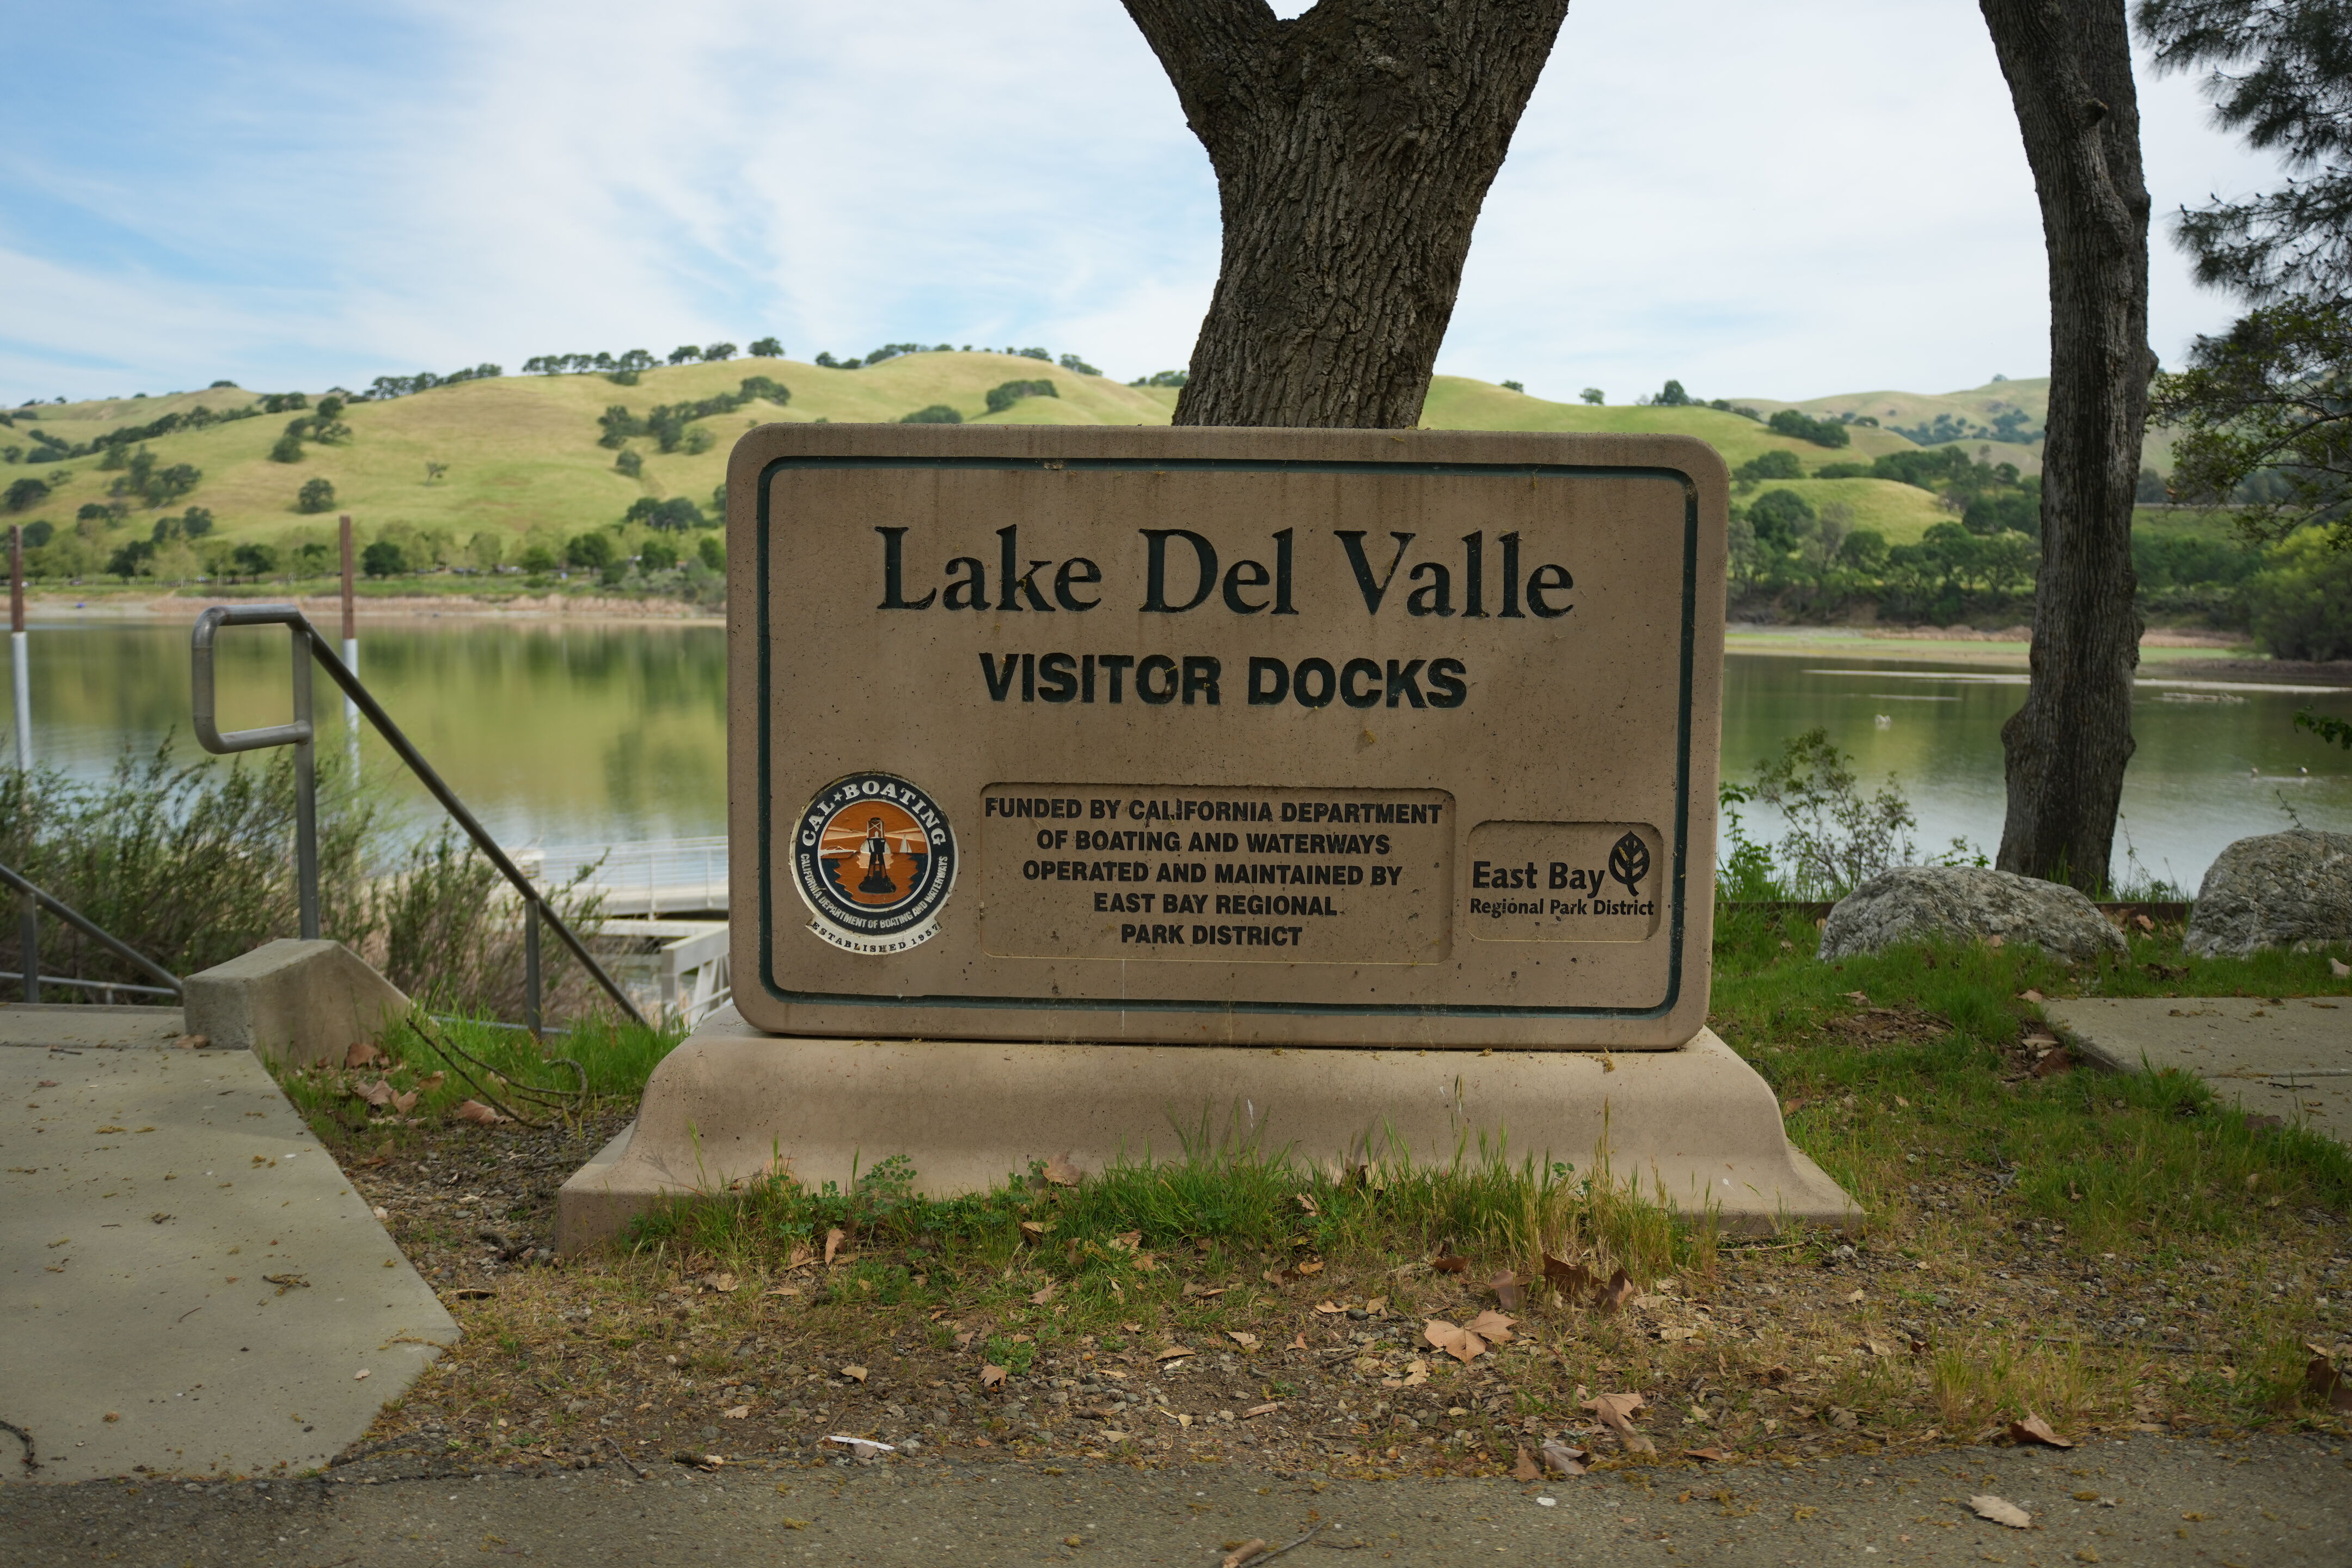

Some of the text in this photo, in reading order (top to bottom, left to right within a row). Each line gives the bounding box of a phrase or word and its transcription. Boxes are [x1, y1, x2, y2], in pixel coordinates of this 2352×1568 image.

[874, 523, 1575, 619] Lake Del Valle
[978, 652, 1468, 709] VISITOR DOCKS
[802, 780, 947, 847] CAL BOATING
[985, 797, 1444, 824] FUNDED BY CALIFORNIA DEPARTMENT
[1036, 829, 1391, 855] OF BOATING AND WATERWAYS
[1022, 860, 1403, 887] OPERATED AND MAINTAINED BY
[1472, 861, 1606, 899] East Bay
[800, 853, 948, 929] CALIFORNIA DEPARTMENT OF BOATING AND WATERWAYS
[1093, 891, 1338, 916] EAST BAY REGIONAL
[1470, 898, 1655, 919] Regional Park District
[811, 921, 941, 953] ESTABLISHED 1957
[1120, 923, 1303, 947] PARK DISTRICT
